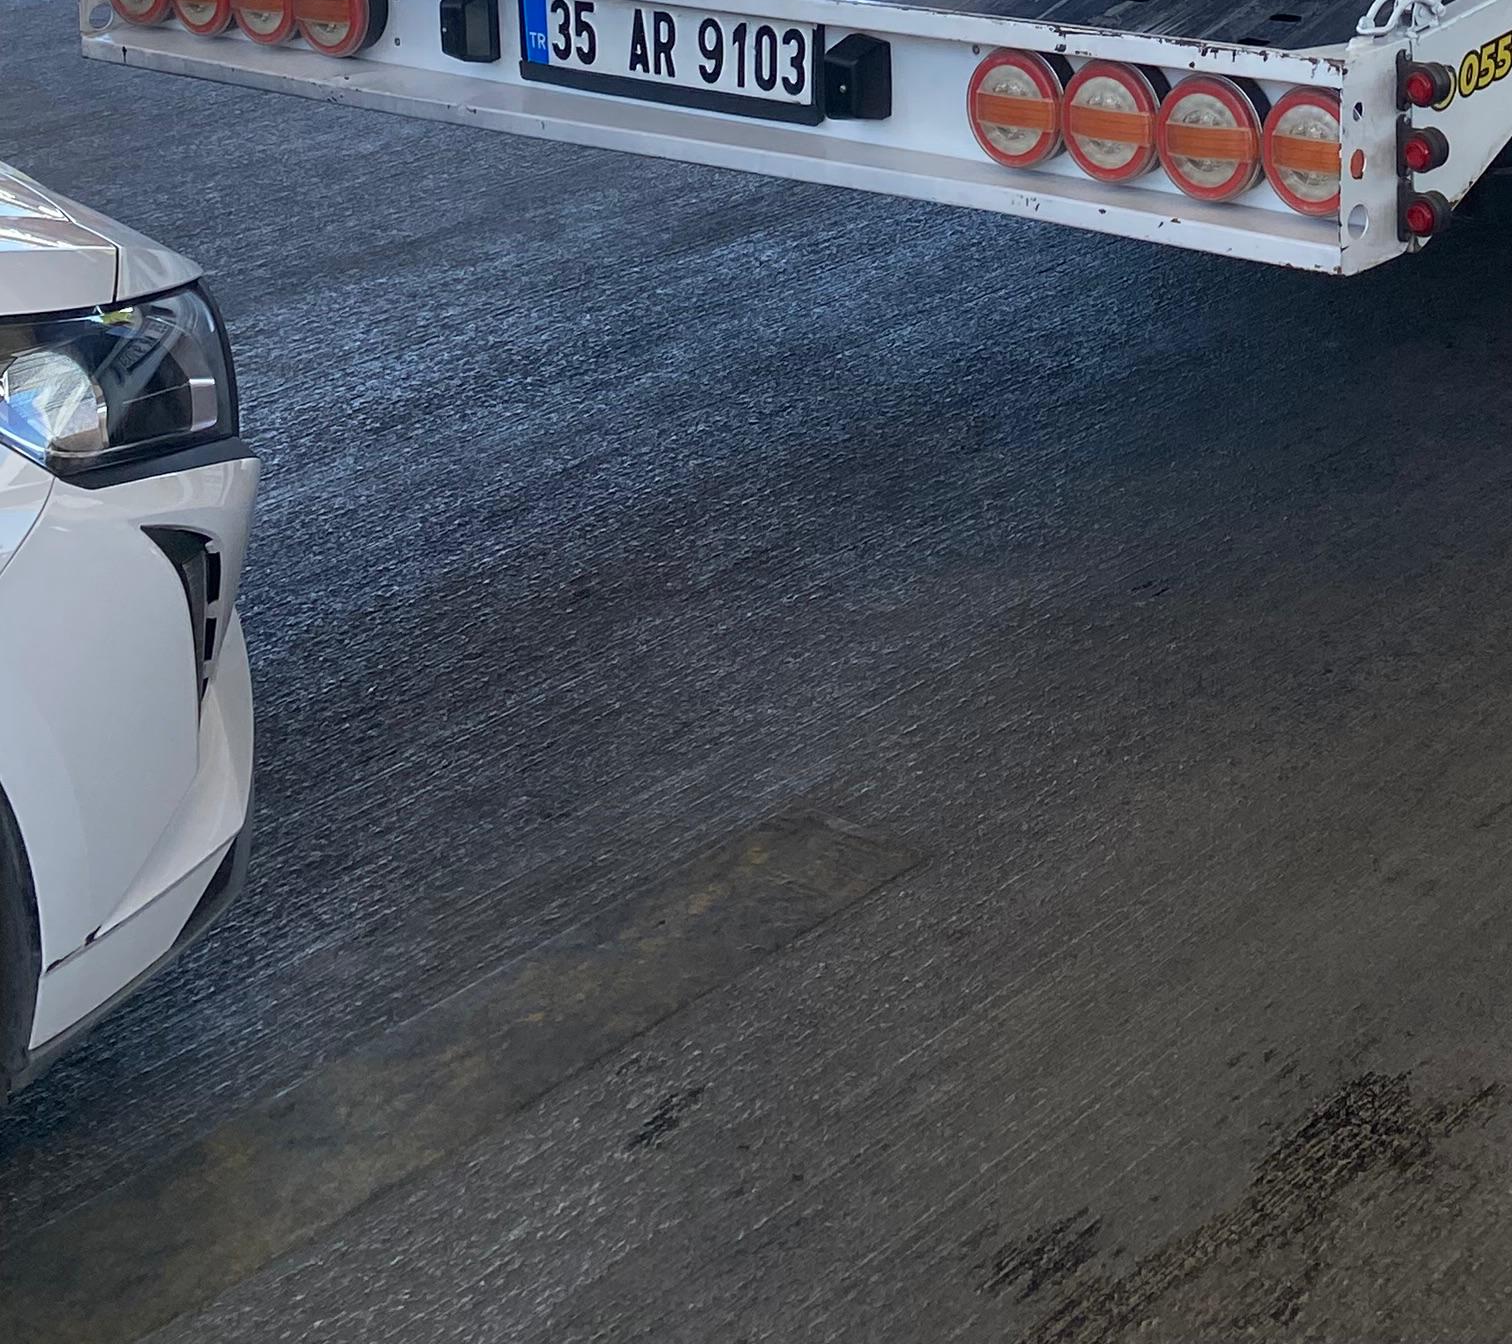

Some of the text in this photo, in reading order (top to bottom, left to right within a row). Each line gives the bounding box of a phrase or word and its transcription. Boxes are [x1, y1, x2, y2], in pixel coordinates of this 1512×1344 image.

[529, 31, 547, 50] TR
[628, 8, 676, 78] AR
[698, 17, 806, 96] 9103
